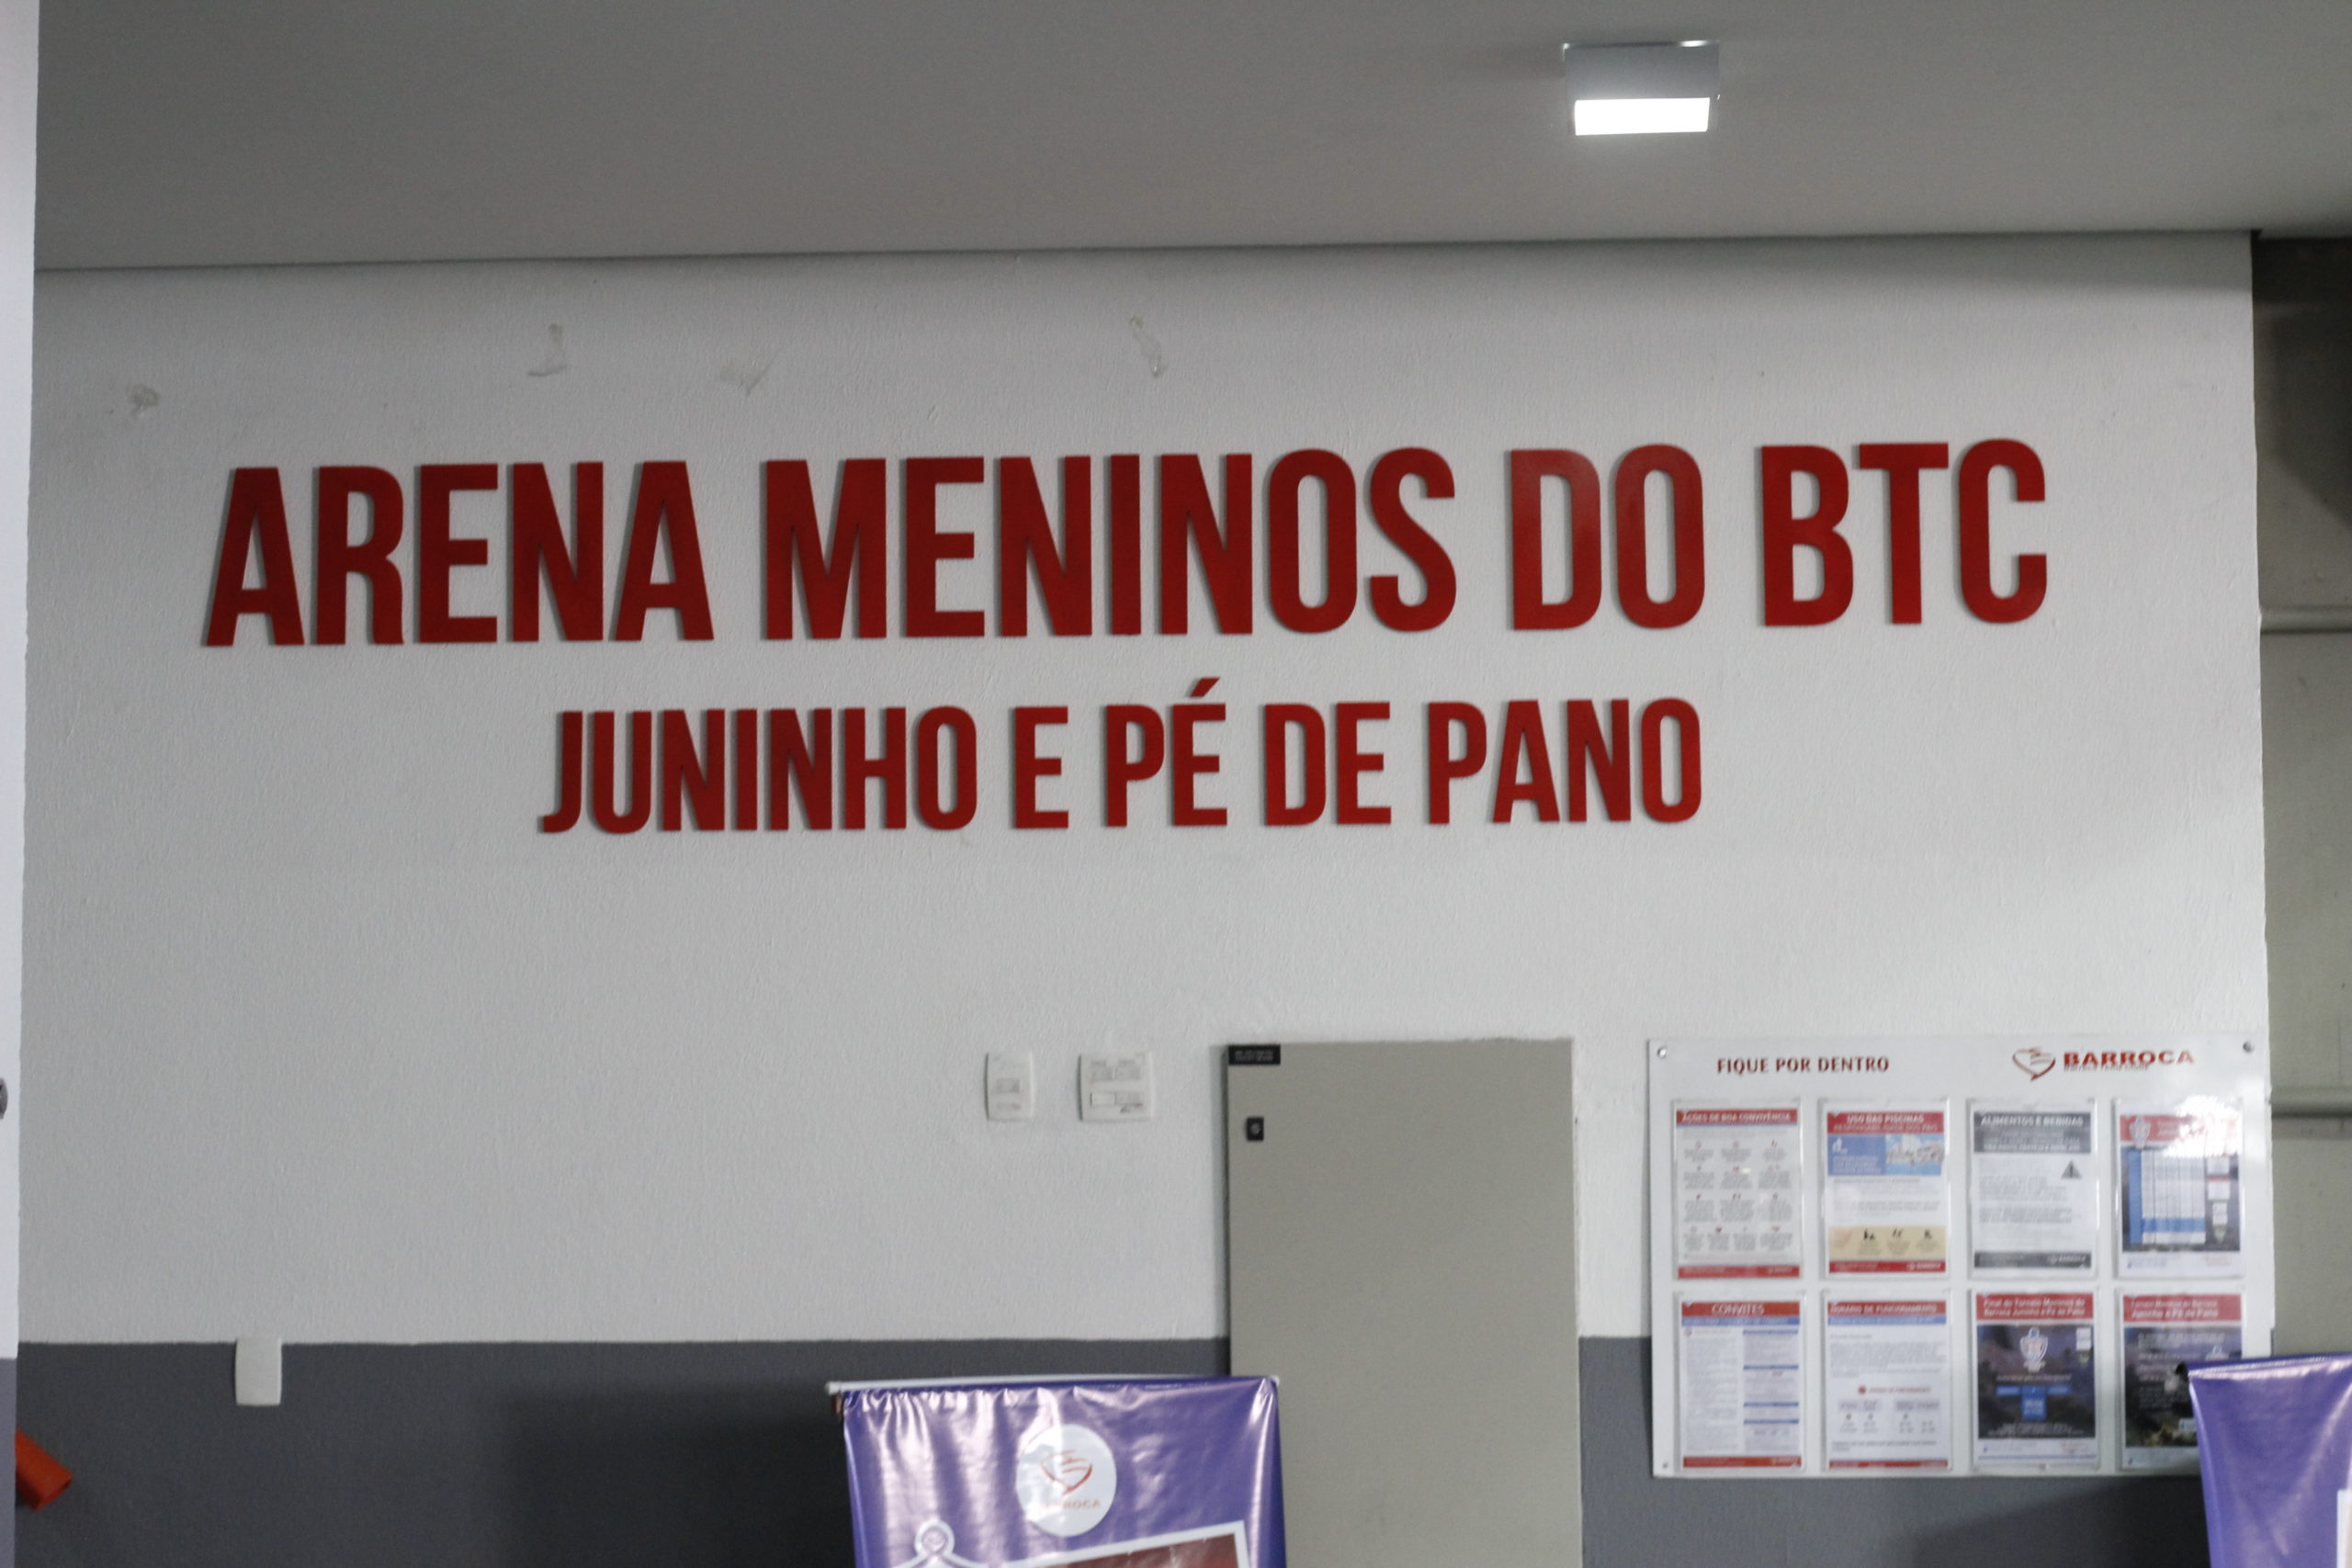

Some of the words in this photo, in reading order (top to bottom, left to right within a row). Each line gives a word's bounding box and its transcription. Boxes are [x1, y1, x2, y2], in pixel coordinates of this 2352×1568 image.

[208, 461, 714, 647] ARENA
[766, 447, 1456, 639] MENINOS
[1511, 445, 1705, 630] DO
[1761, 439, 2047, 626] BTC
[542, 706, 978, 835] JUNINHO
[1014, 705, 1070, 829] E
[1106, 678, 1228, 828] PÉ
[1265, 702, 1393, 827] DE
[1429, 698, 1702, 826] PANO
[1717, 1057, 1768, 1076] FIQUE
[1775, 1057, 1810, 1073] POR
[1817, 1056, 1890, 1073] DENTRO
[2064, 1050, 2194, 1067] BARROCA
